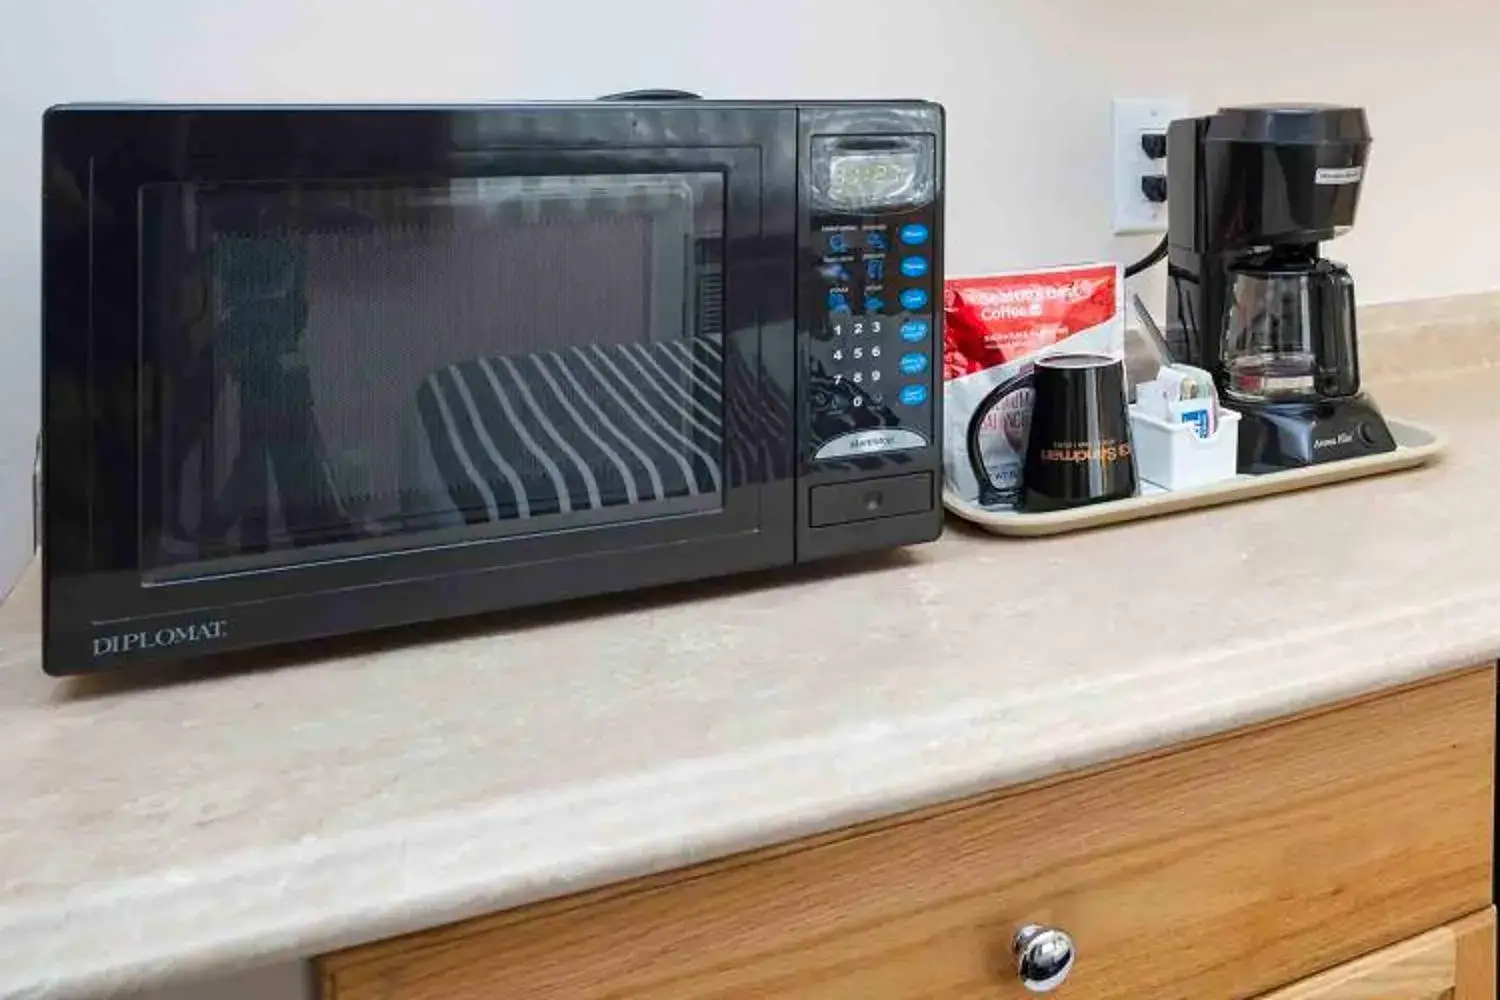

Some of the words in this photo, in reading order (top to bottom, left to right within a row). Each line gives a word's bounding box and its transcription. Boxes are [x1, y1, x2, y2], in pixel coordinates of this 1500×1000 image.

[853, 322, 864, 335] 2
[871, 321, 881, 333] 3
[833, 349, 843, 361] 4
[853, 347, 864, 359] 5
[871, 345, 881, 358] 6
[853, 371, 864, 384] 8
[871, 369, 881, 382] 9
[853, 395, 864, 408] 0
[92, 619, 229, 657] DIPLOMAT
